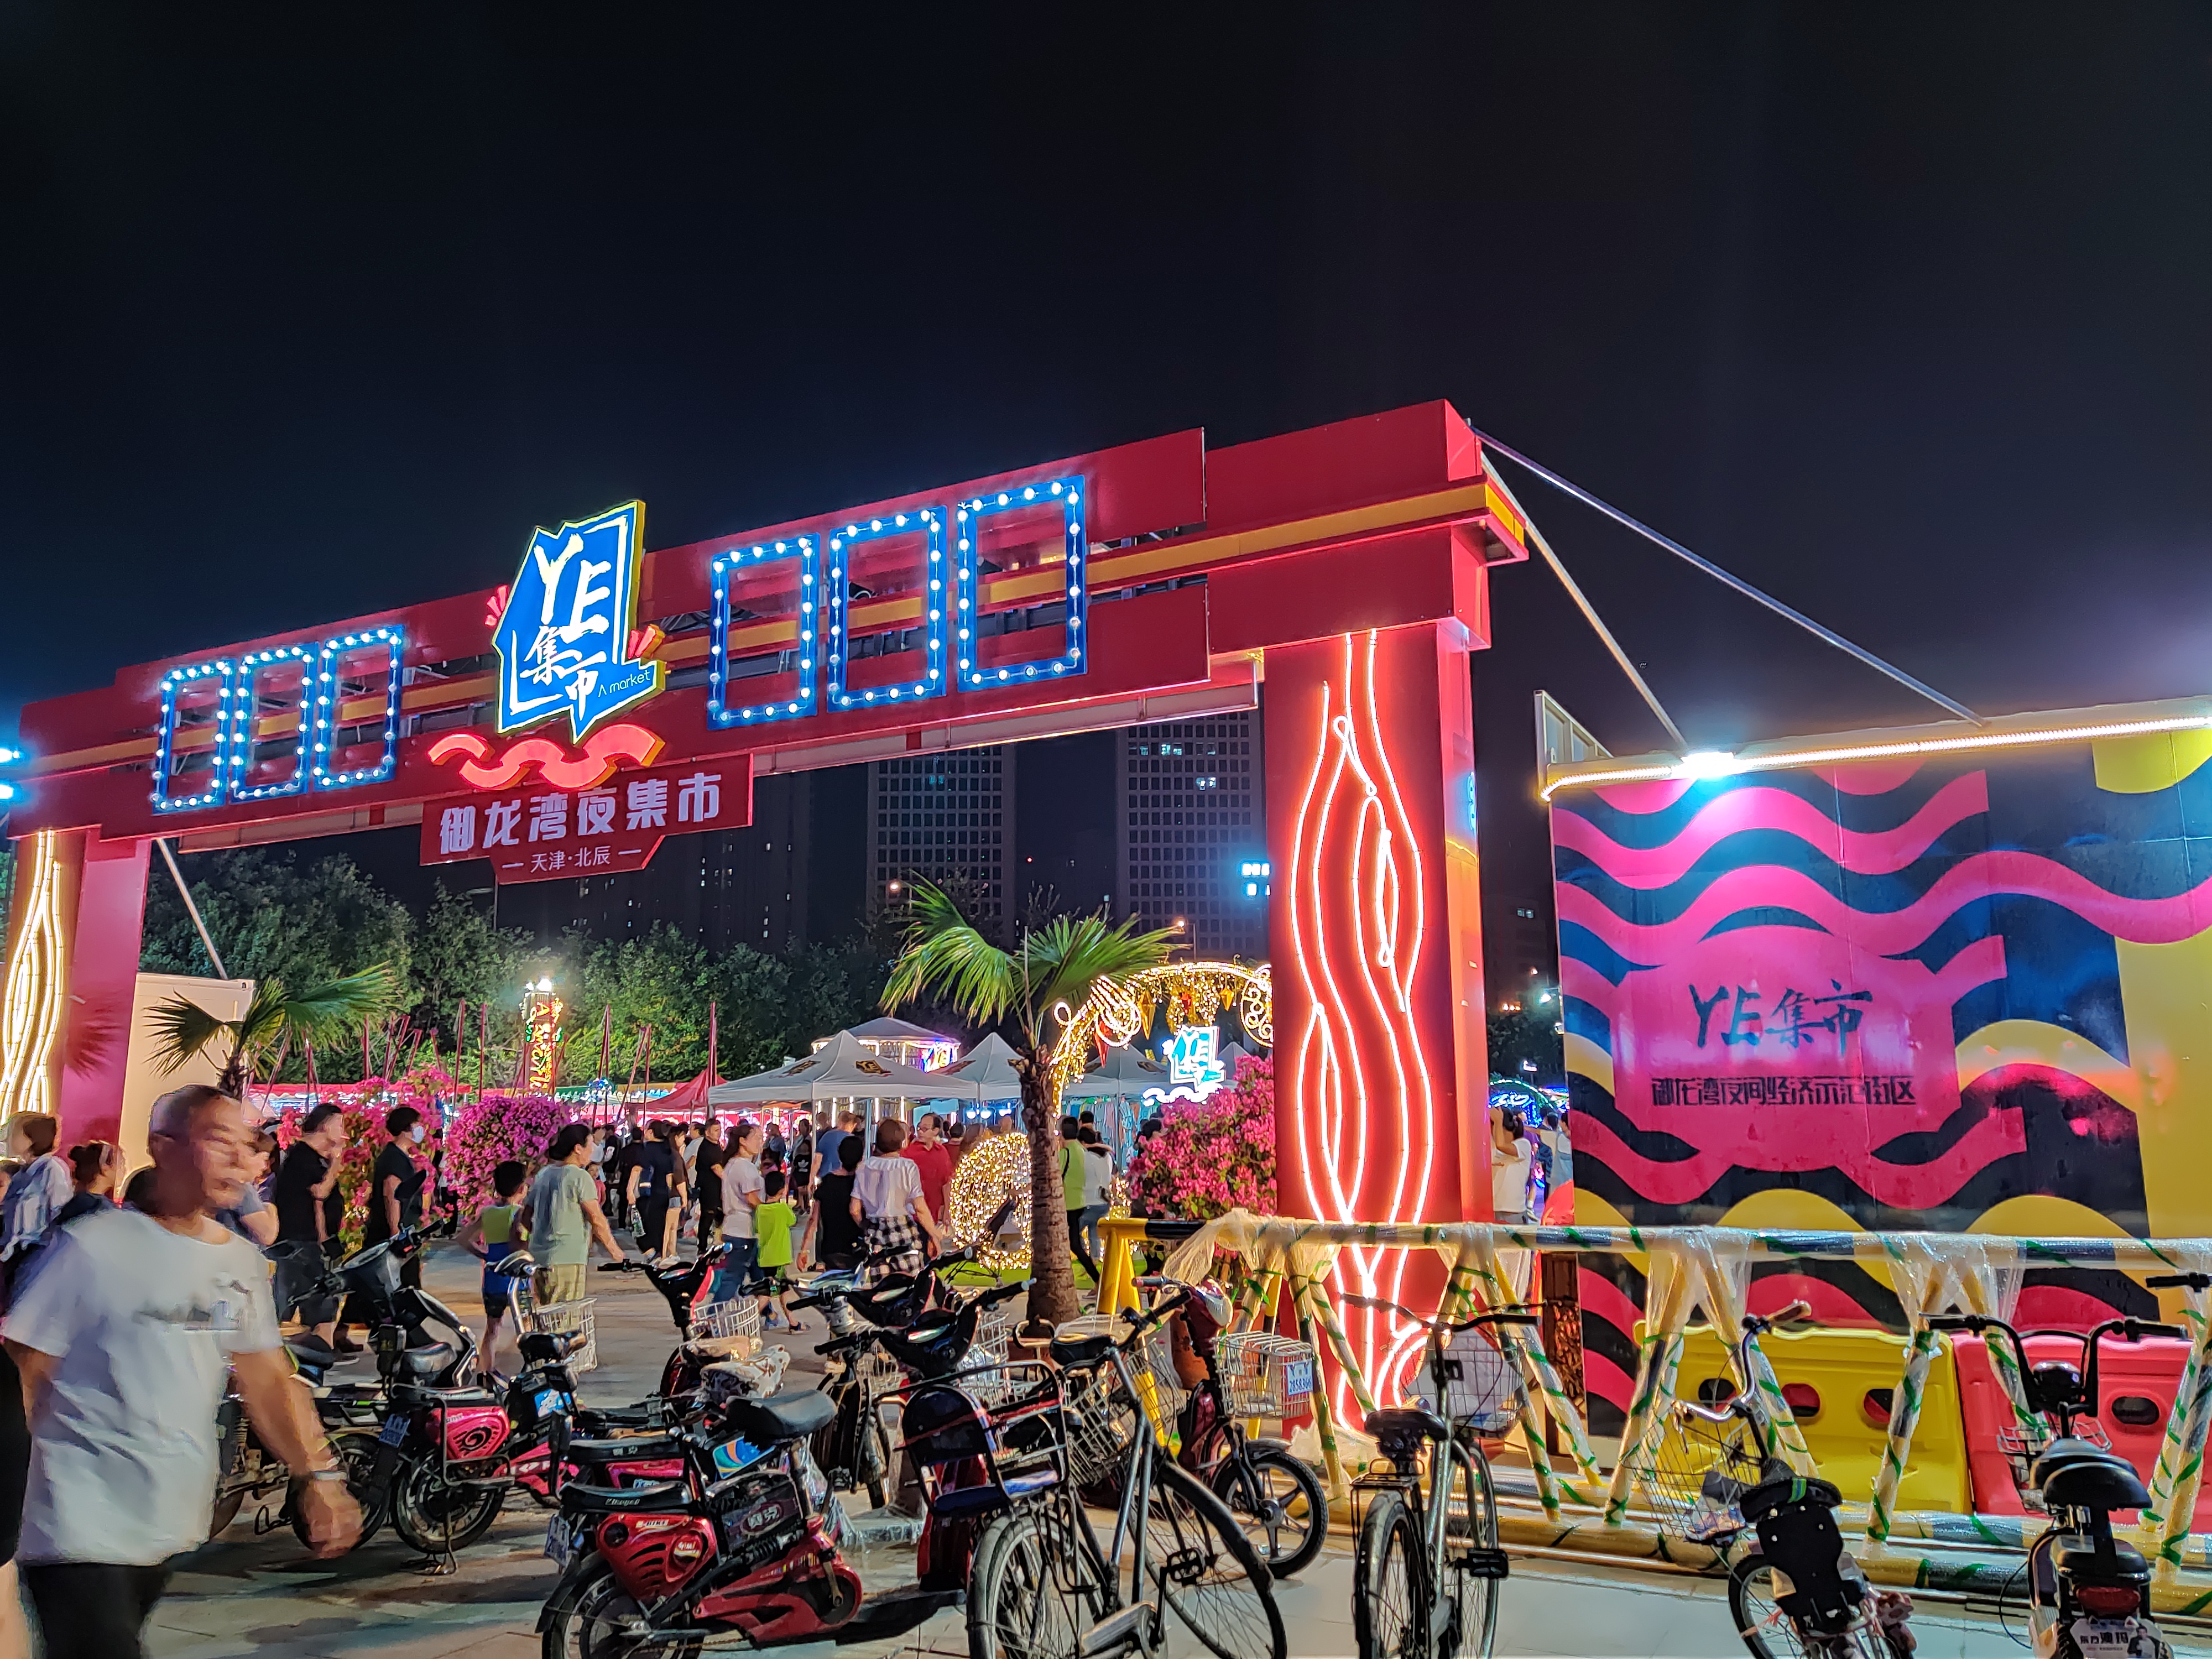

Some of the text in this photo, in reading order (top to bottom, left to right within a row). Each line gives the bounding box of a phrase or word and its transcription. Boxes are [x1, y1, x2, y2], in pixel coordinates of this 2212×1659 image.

[533, 533, 612, 644] YE
[519, 625, 607, 721] 集市
[609, 670, 650, 693] market
[439, 772, 722, 854] 御龙湾夜集市
